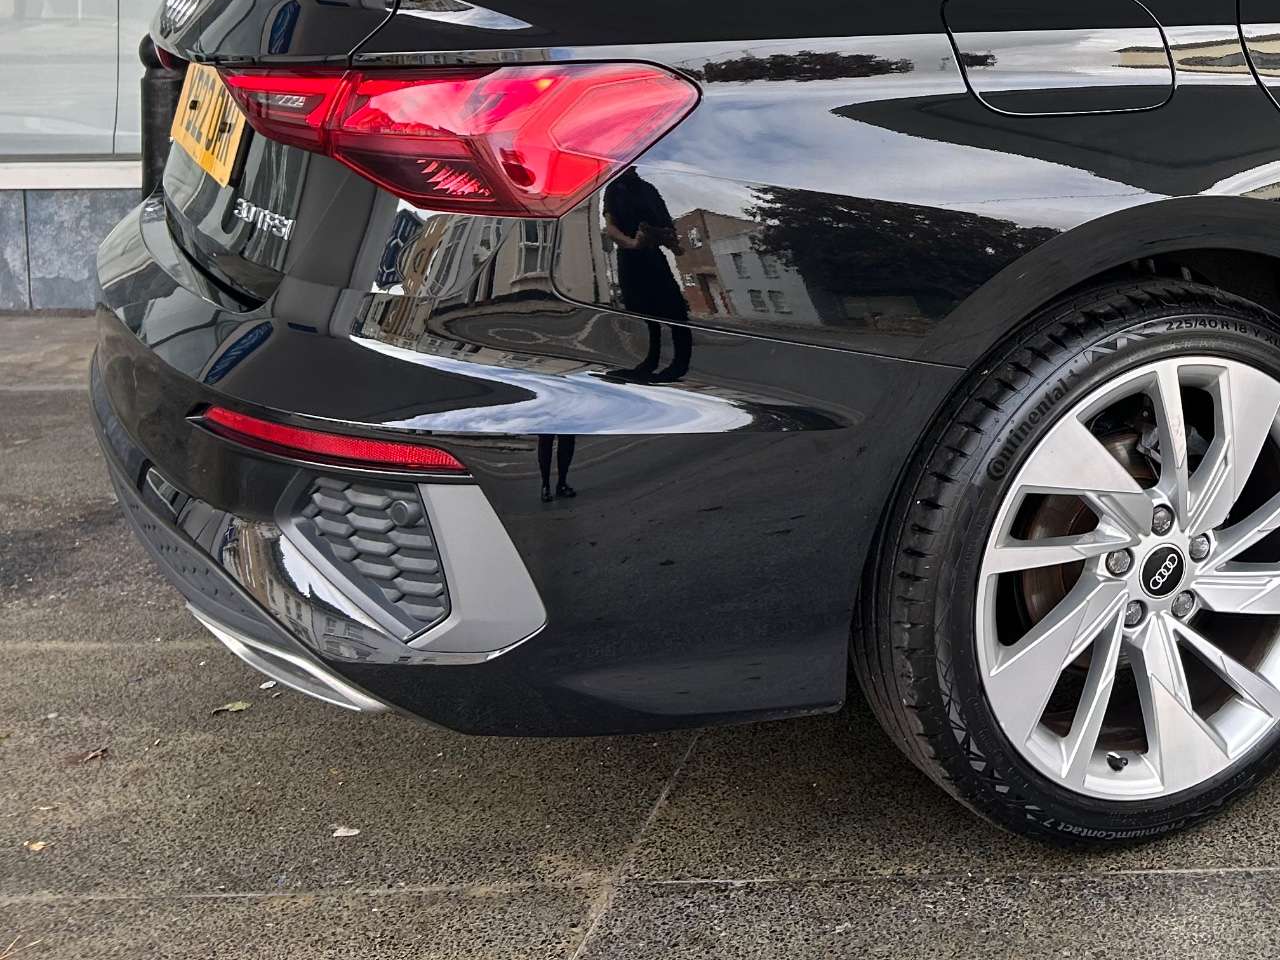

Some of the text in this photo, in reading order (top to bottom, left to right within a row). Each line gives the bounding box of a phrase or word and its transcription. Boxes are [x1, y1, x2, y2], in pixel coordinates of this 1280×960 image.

[1165, 319, 1218, 331] 225/40
[1220, 319, 1230, 330] R
[1234, 322, 1248, 334] 18
[986, 378, 1070, 481] Continental
[1057, 819, 1186, 840] PremiumContact
